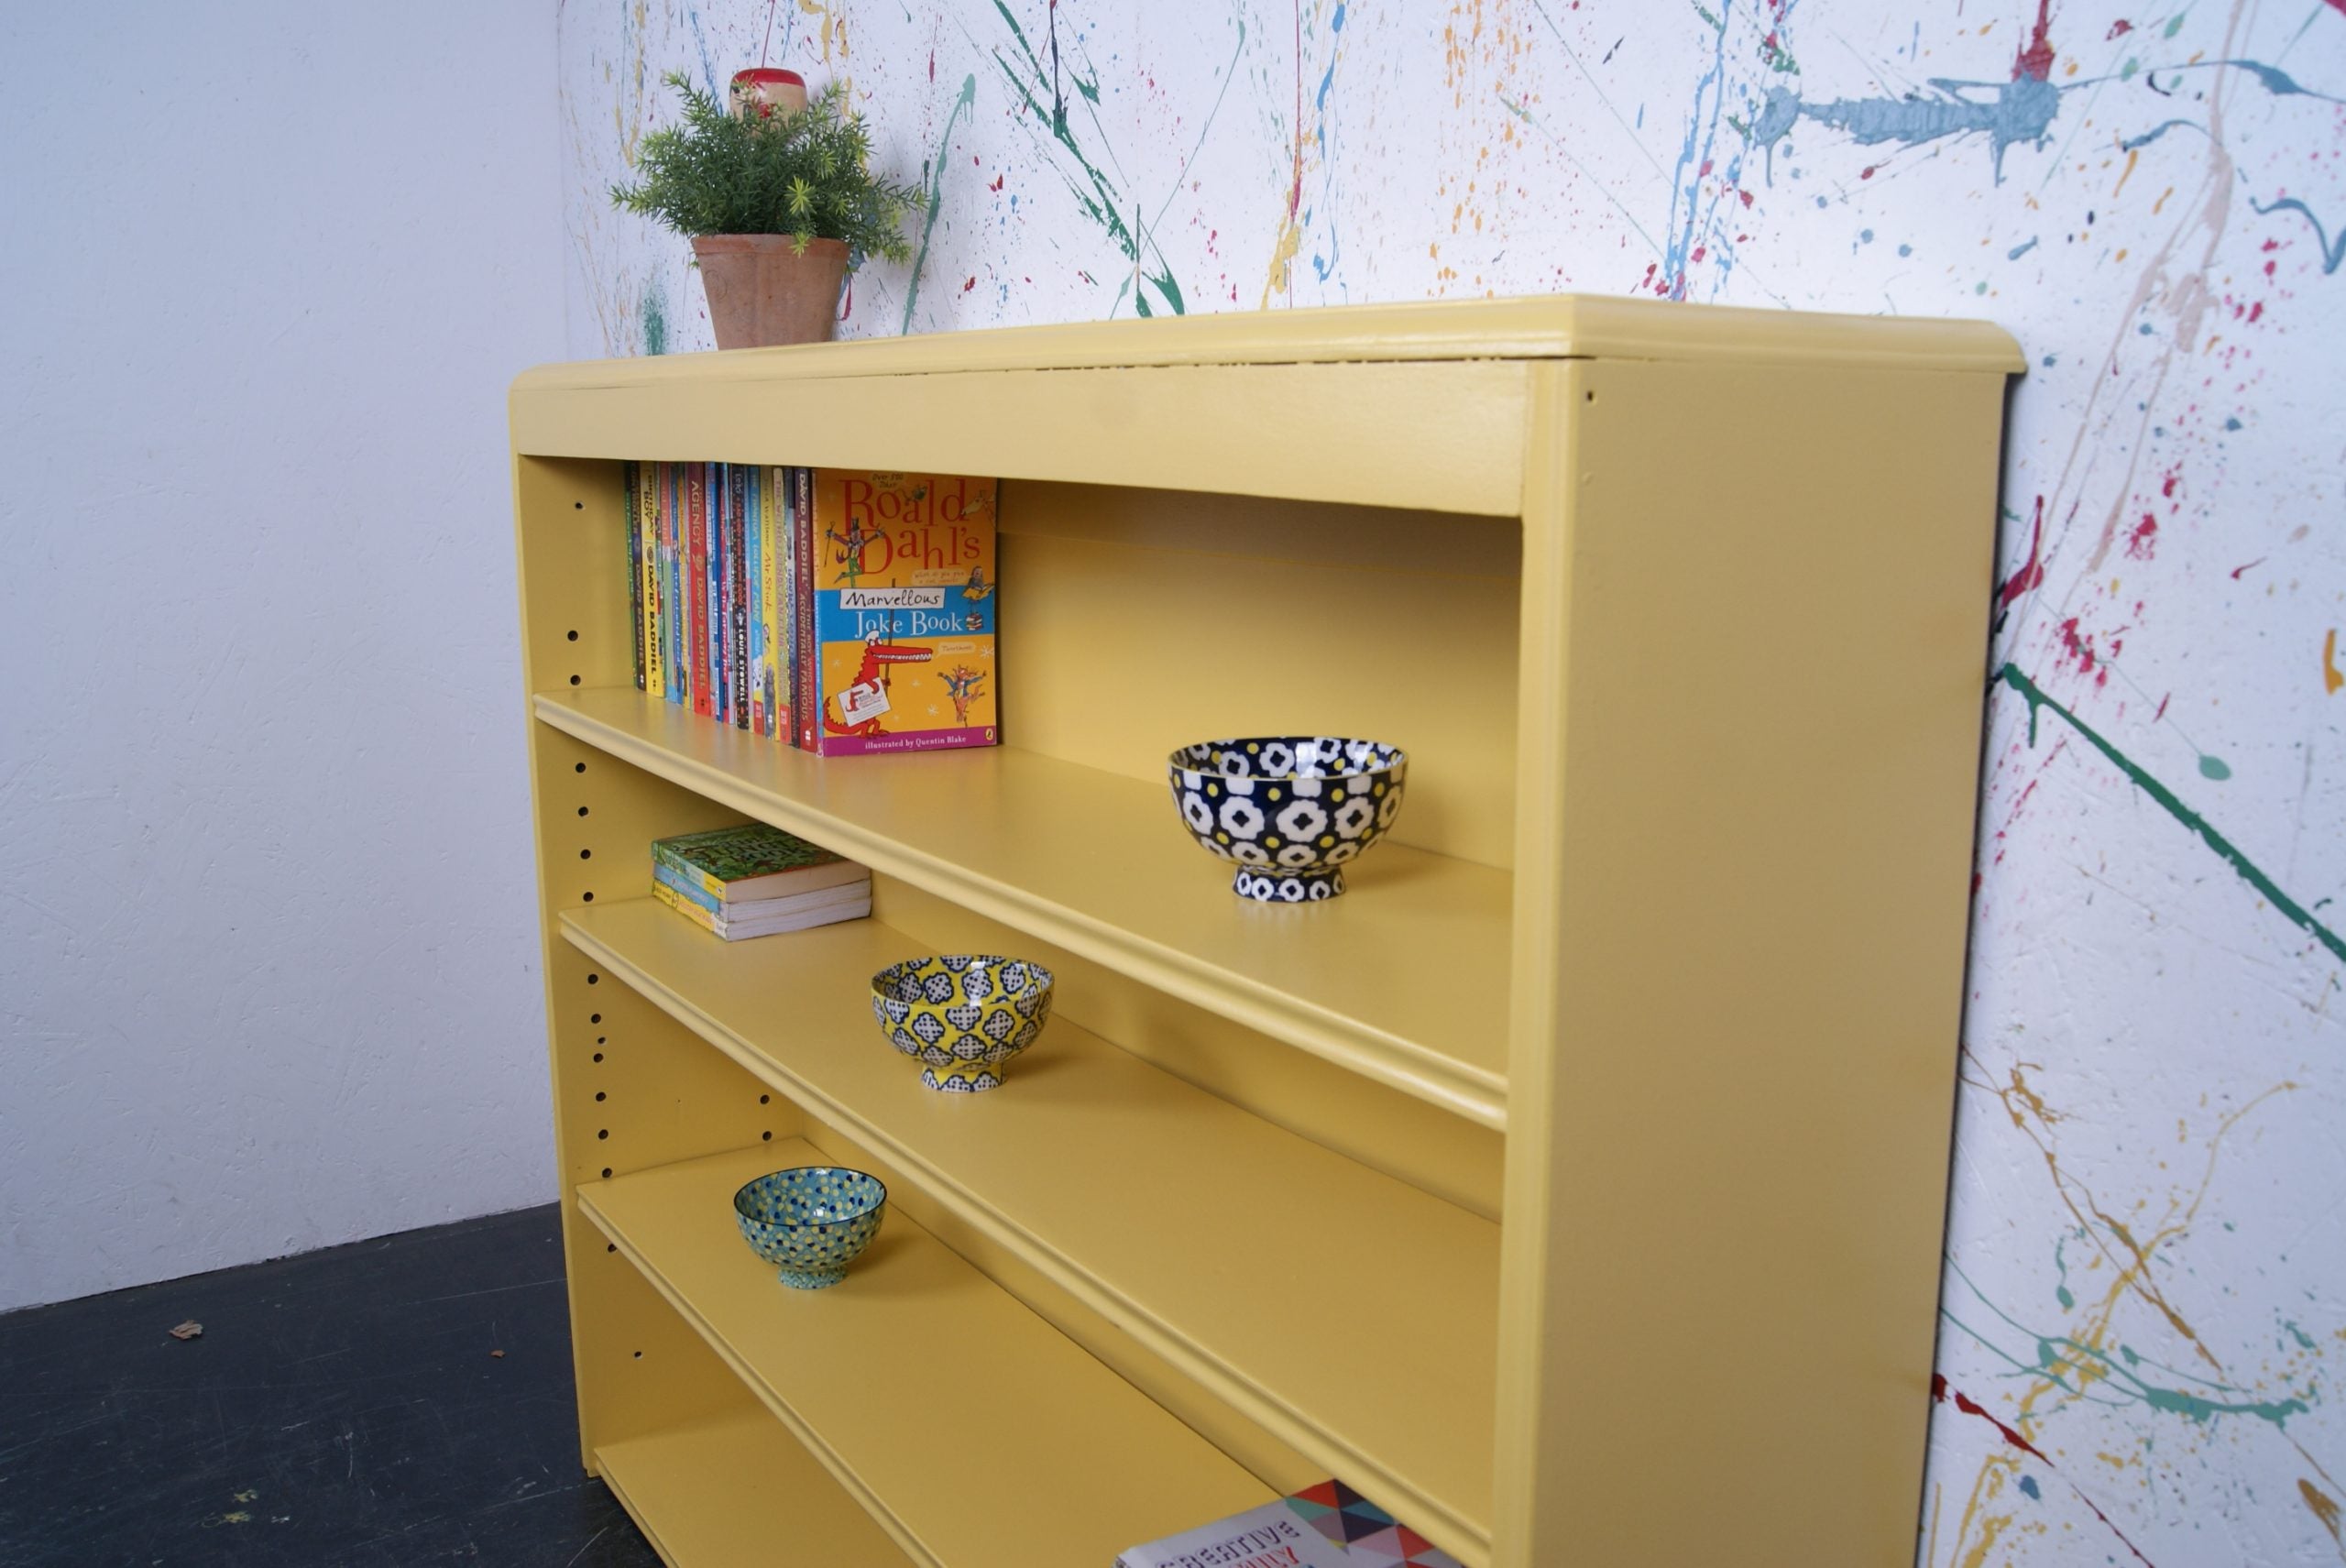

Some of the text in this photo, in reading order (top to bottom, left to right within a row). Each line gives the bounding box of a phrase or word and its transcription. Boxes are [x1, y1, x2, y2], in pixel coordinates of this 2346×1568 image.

[691, 480, 701, 547] AGENCY
[799, 473, 808, 516] DAVID
[838, 478, 970, 537] Roald
[858, 526, 981, 575] Dahl's
[845, 589, 941, 607] Marvellous
[696, 576, 706, 689] DAVID BADDIEL
[854, 610, 963, 639] Joke Book
[799, 593, 808, 721] ACCIDENTALLY FAMOUS
[865, 733, 967, 750] illustrated by Quentin Blake
